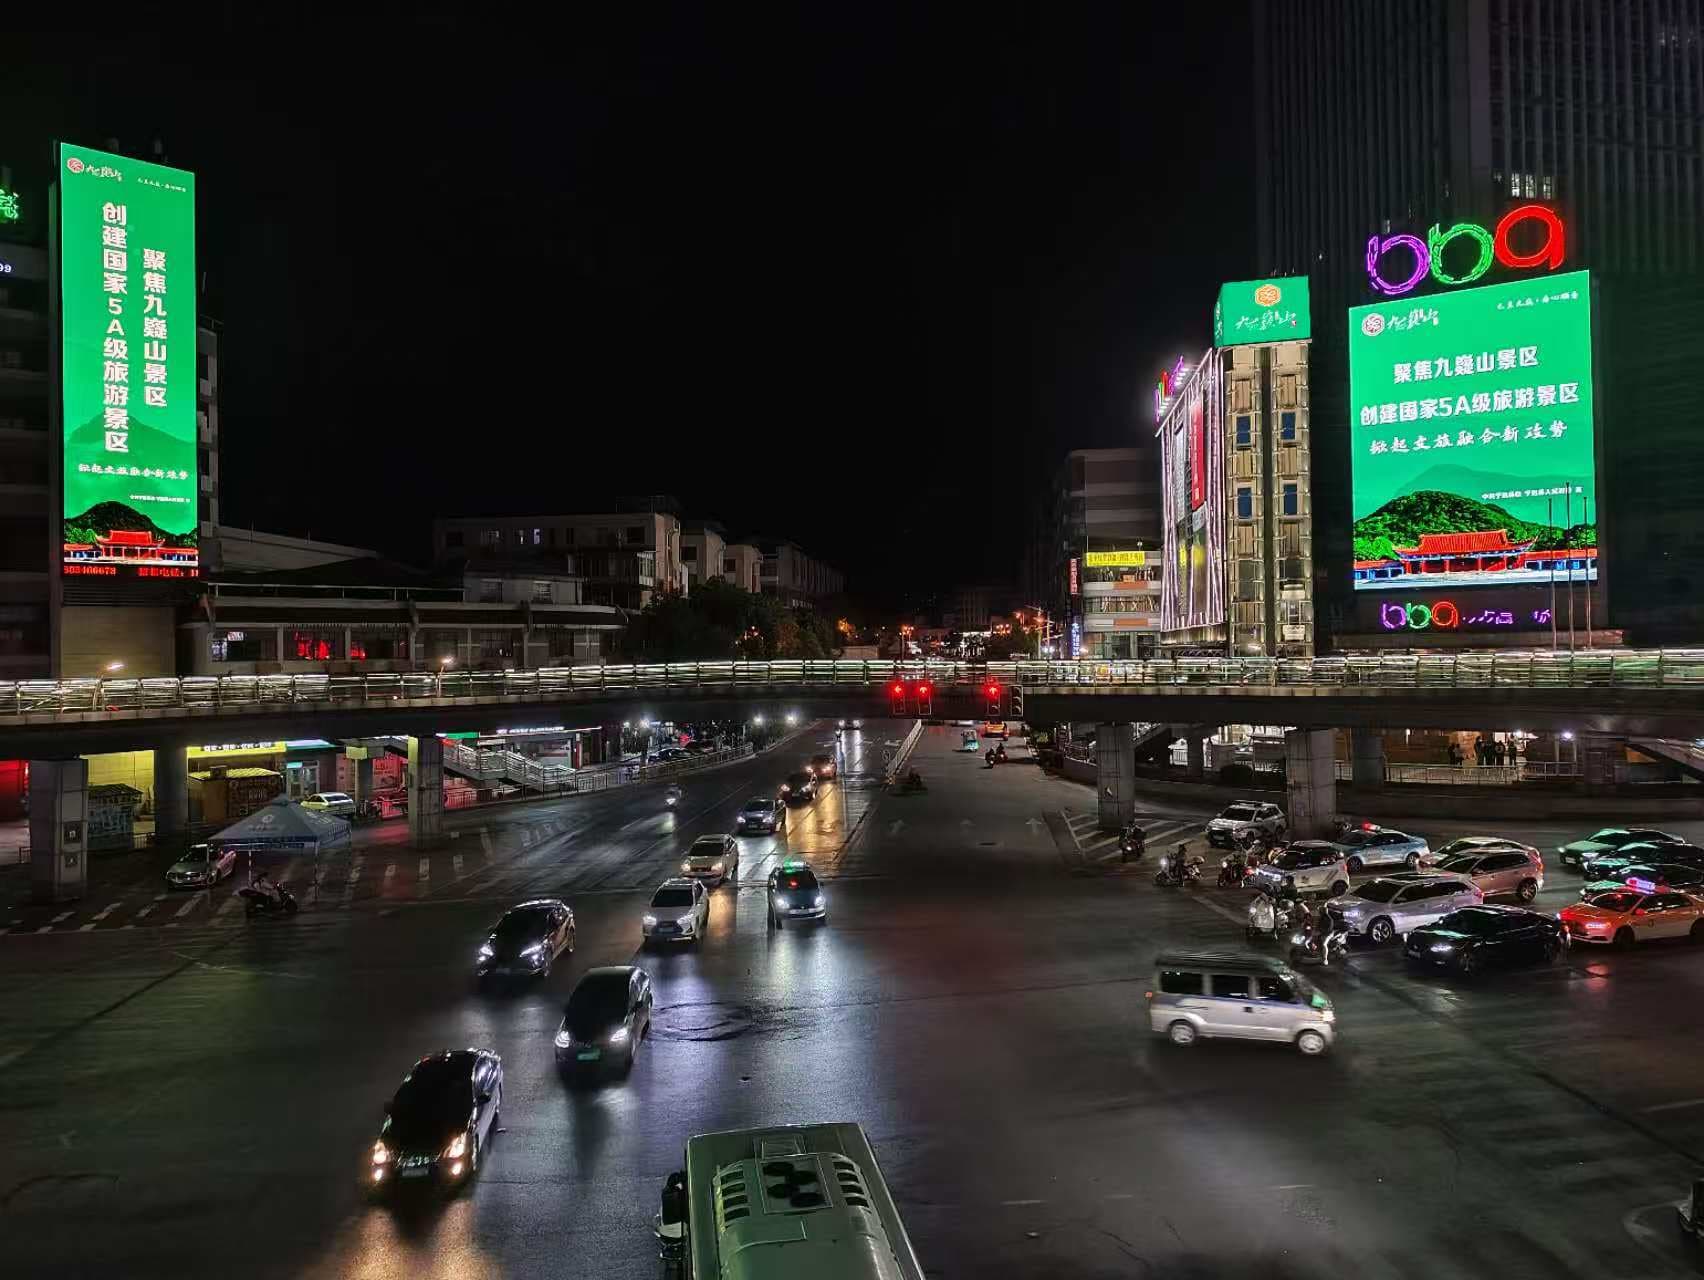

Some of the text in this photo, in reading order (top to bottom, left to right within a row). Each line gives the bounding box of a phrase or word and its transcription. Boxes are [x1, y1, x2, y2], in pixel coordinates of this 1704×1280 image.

[102, 202, 129, 453] 创建国家5A级旅游景区
[1360, 382, 1580, 426] 创建国家5A级旅游景区
